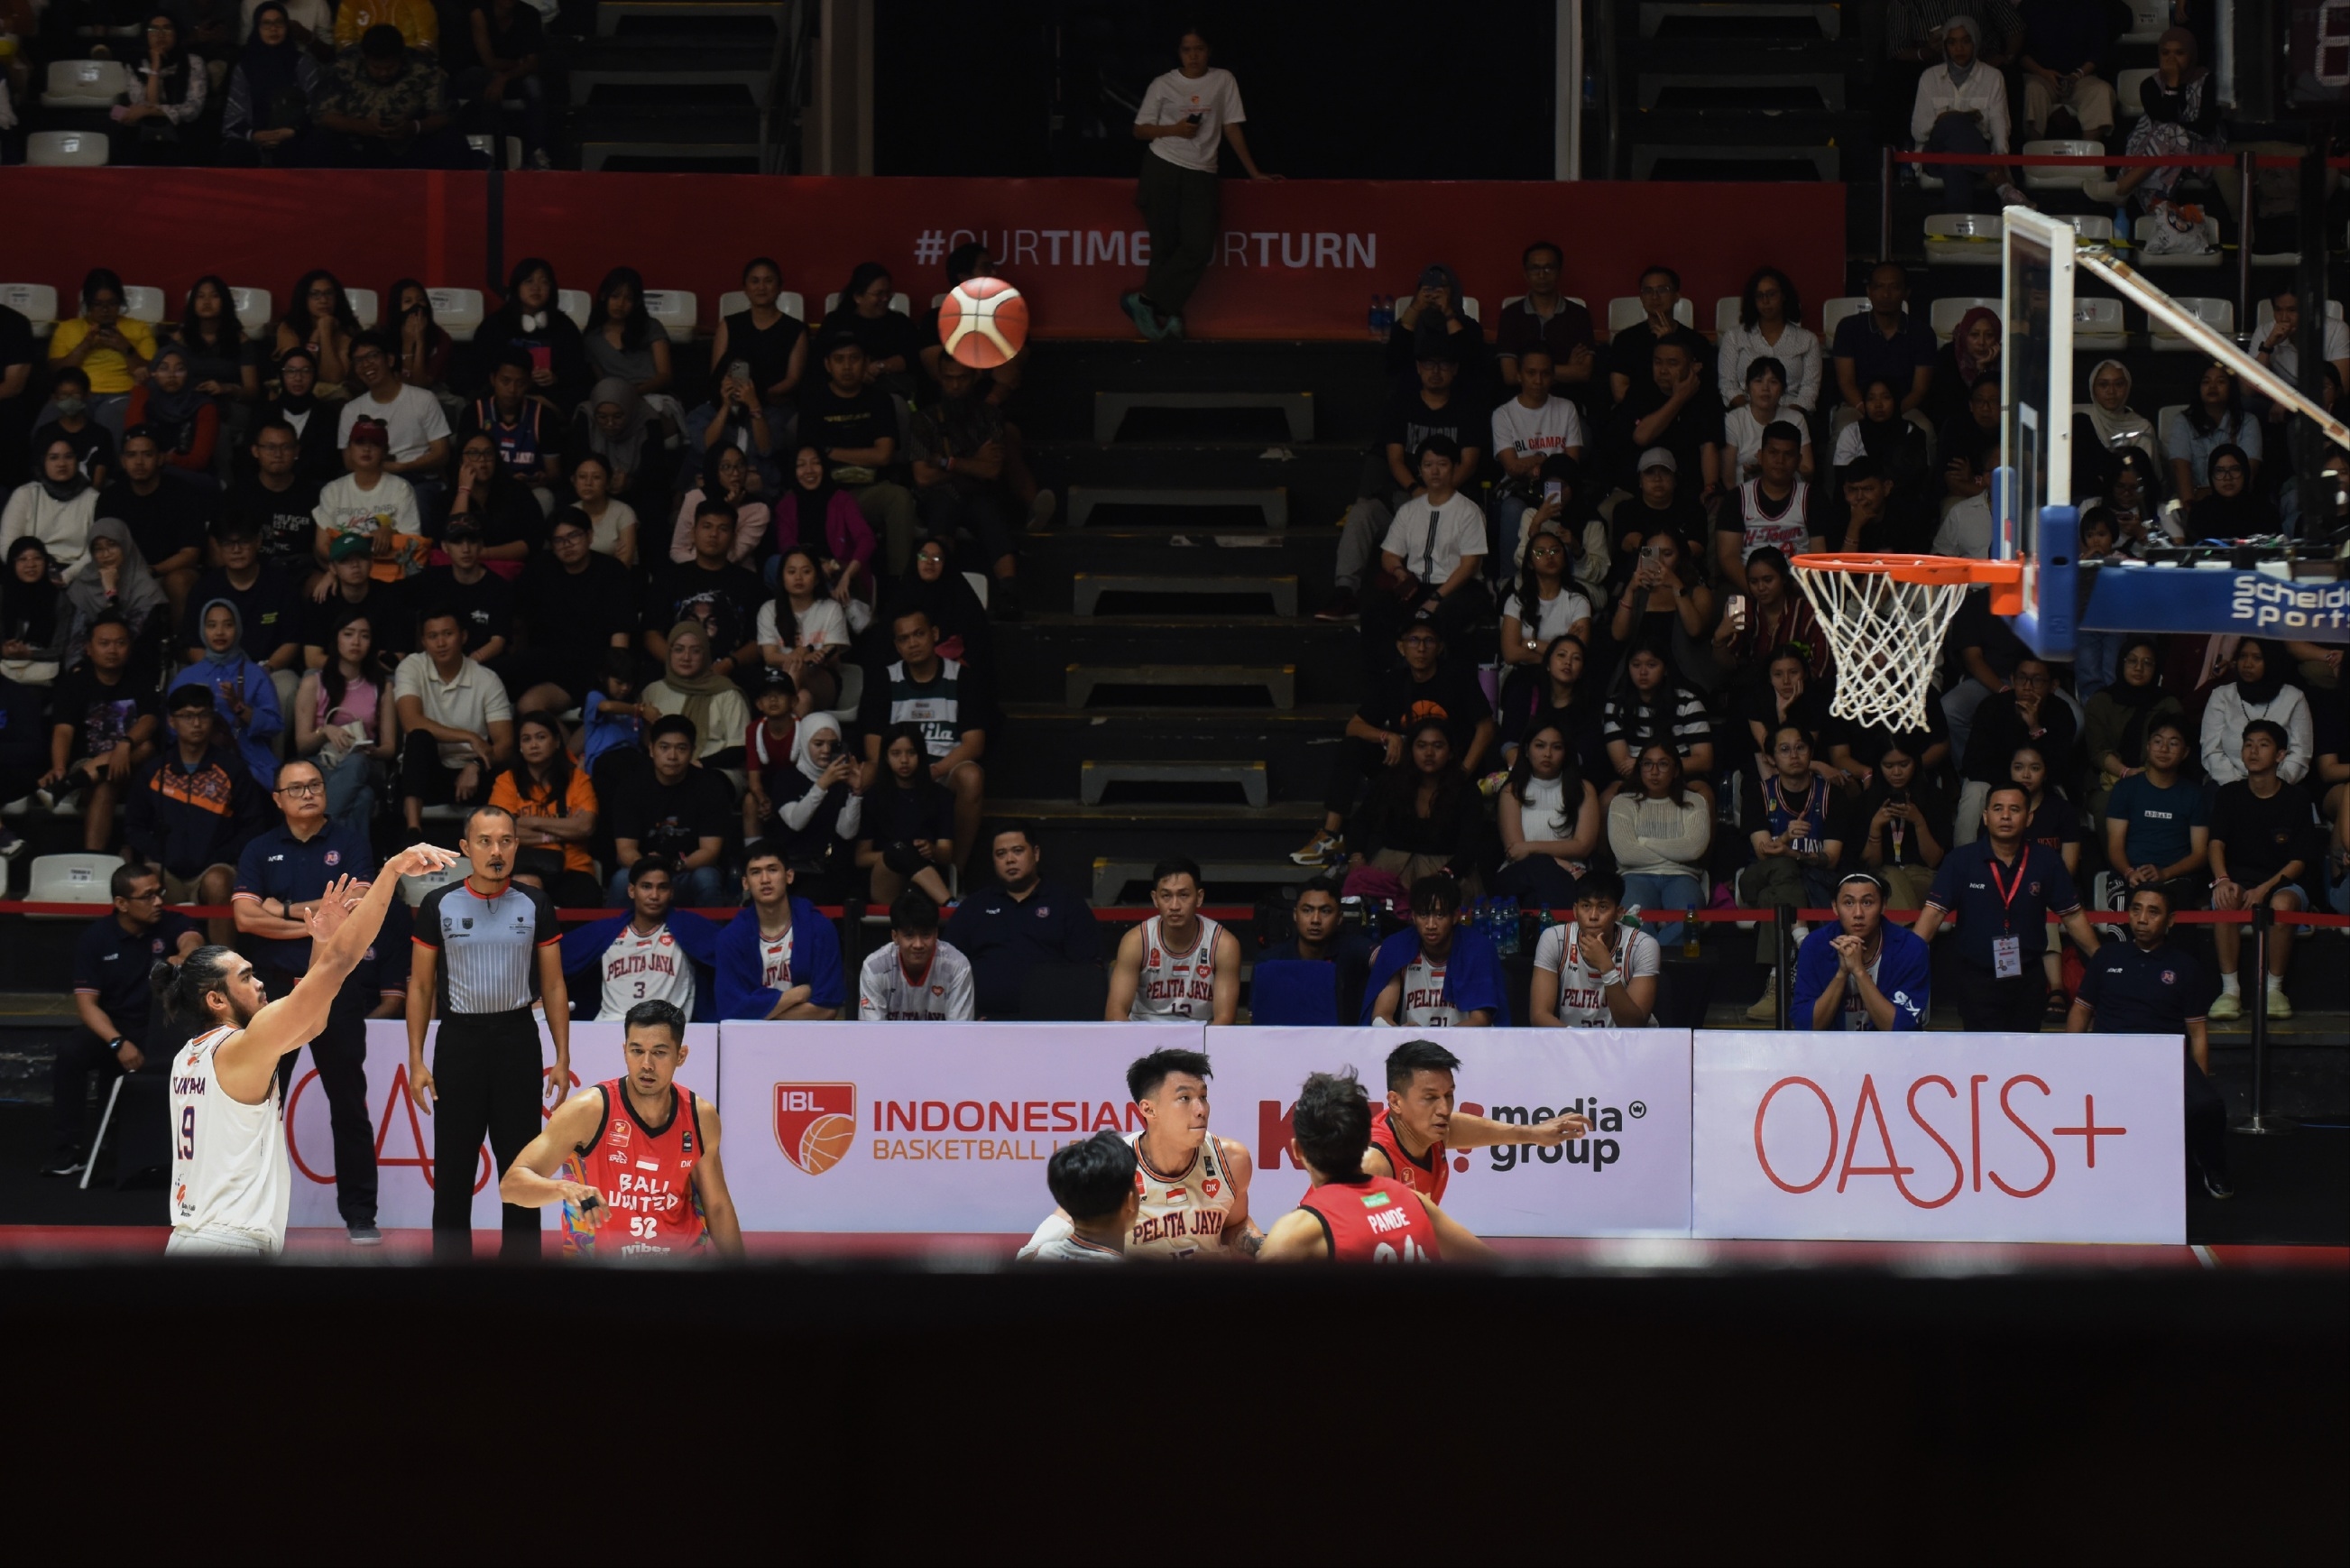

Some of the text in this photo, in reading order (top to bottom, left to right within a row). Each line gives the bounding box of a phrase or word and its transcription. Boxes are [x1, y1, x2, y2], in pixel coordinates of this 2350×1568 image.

[1528, 436, 1567, 450] CHAMPS
[606, 953, 676, 982] PELITA JAYA
[633, 982, 646, 1000] 3
[1147, 979, 1214, 1002] PELITA JAYA
[1562, 988, 1600, 1010] PELITA
[781, 1091, 825, 1111] IBL
[873, 1100, 1148, 1133] INDONESIAN
[872, 1139, 1046, 1161] BASKETBALL
[1754, 1074, 2127, 1209] OASIS+
[680, 1159, 693, 1168] DK
[1489, 1138, 1621, 1173] group
[619, 1173, 669, 1195] BALI
[1205, 1183, 1217, 1193] DK
[629, 1216, 658, 1240] 52
[1132, 1210, 1223, 1245] PELITA JAYA
[1367, 1206, 1411, 1234] PANDE
